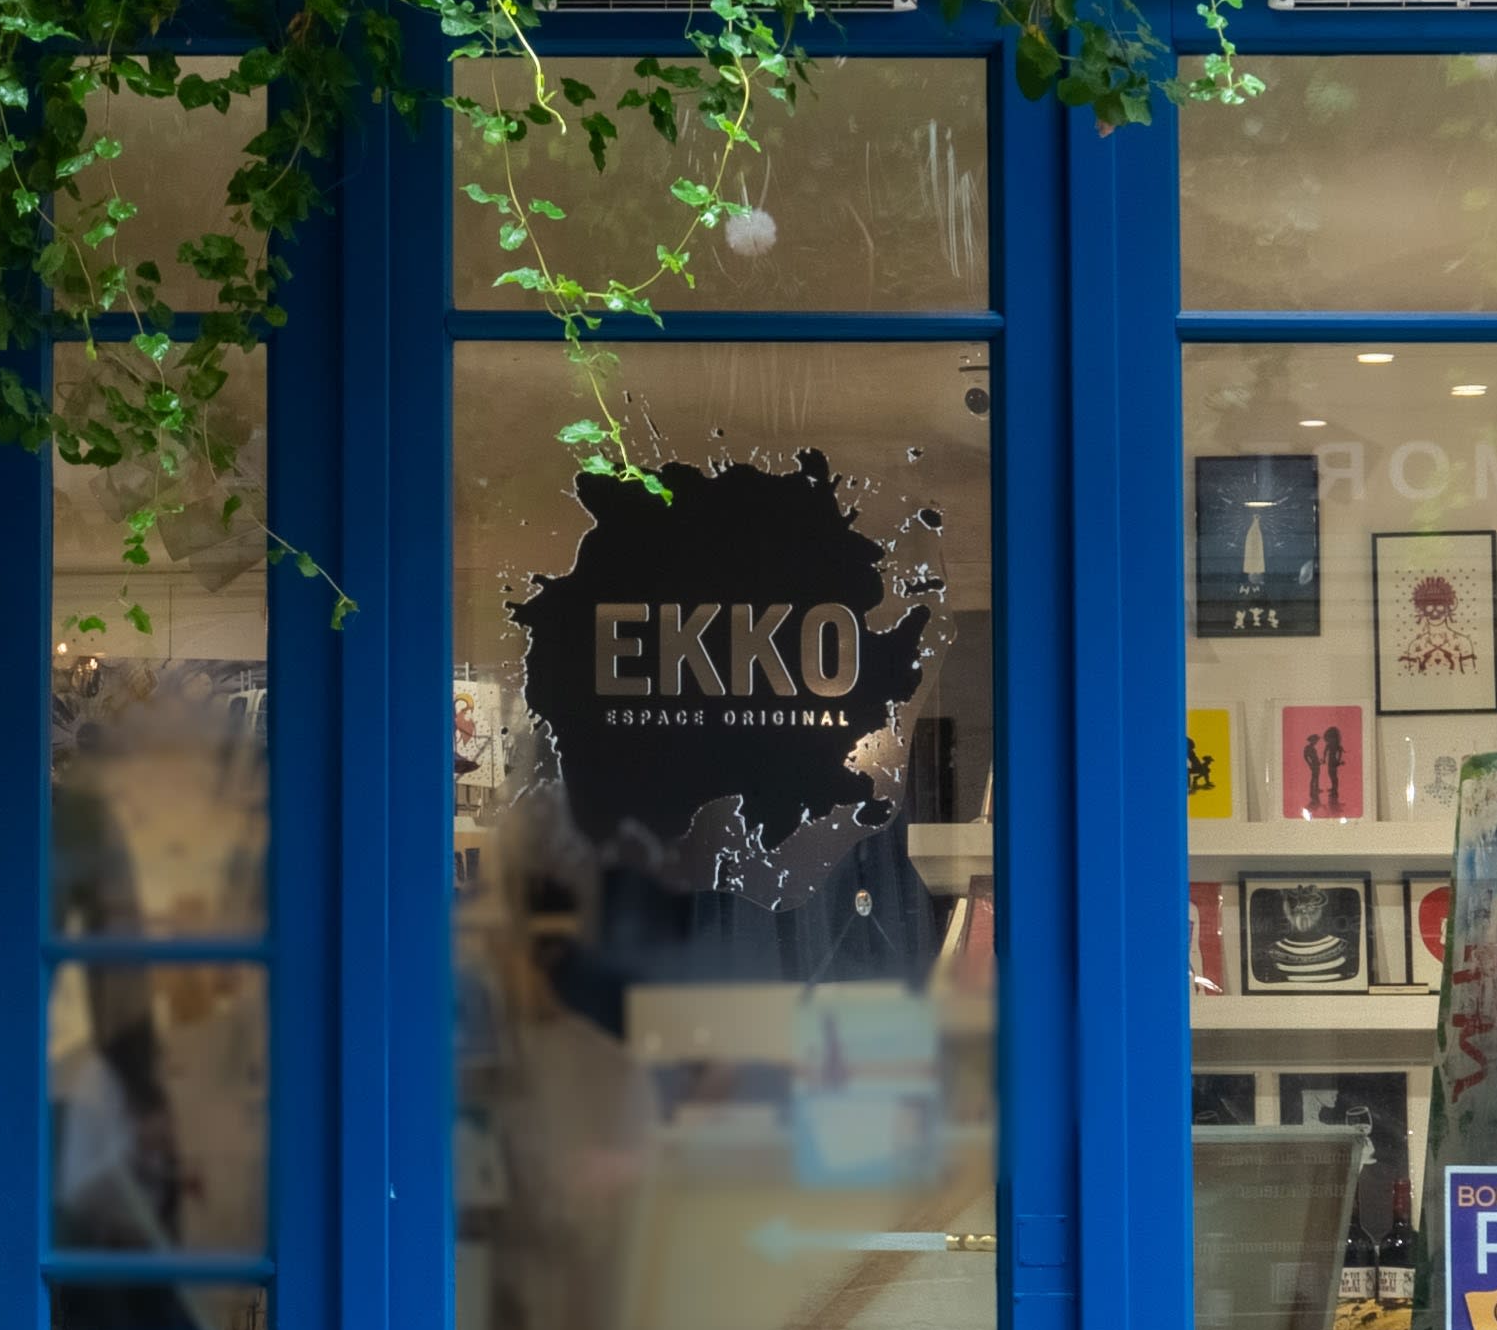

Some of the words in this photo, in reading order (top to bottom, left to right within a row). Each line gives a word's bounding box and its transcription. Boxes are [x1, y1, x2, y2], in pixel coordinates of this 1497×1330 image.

[595, 603, 860, 698] EKKO
[606, 709, 705, 727] ESPACE
[723, 709, 850, 727] ORIGINAL
